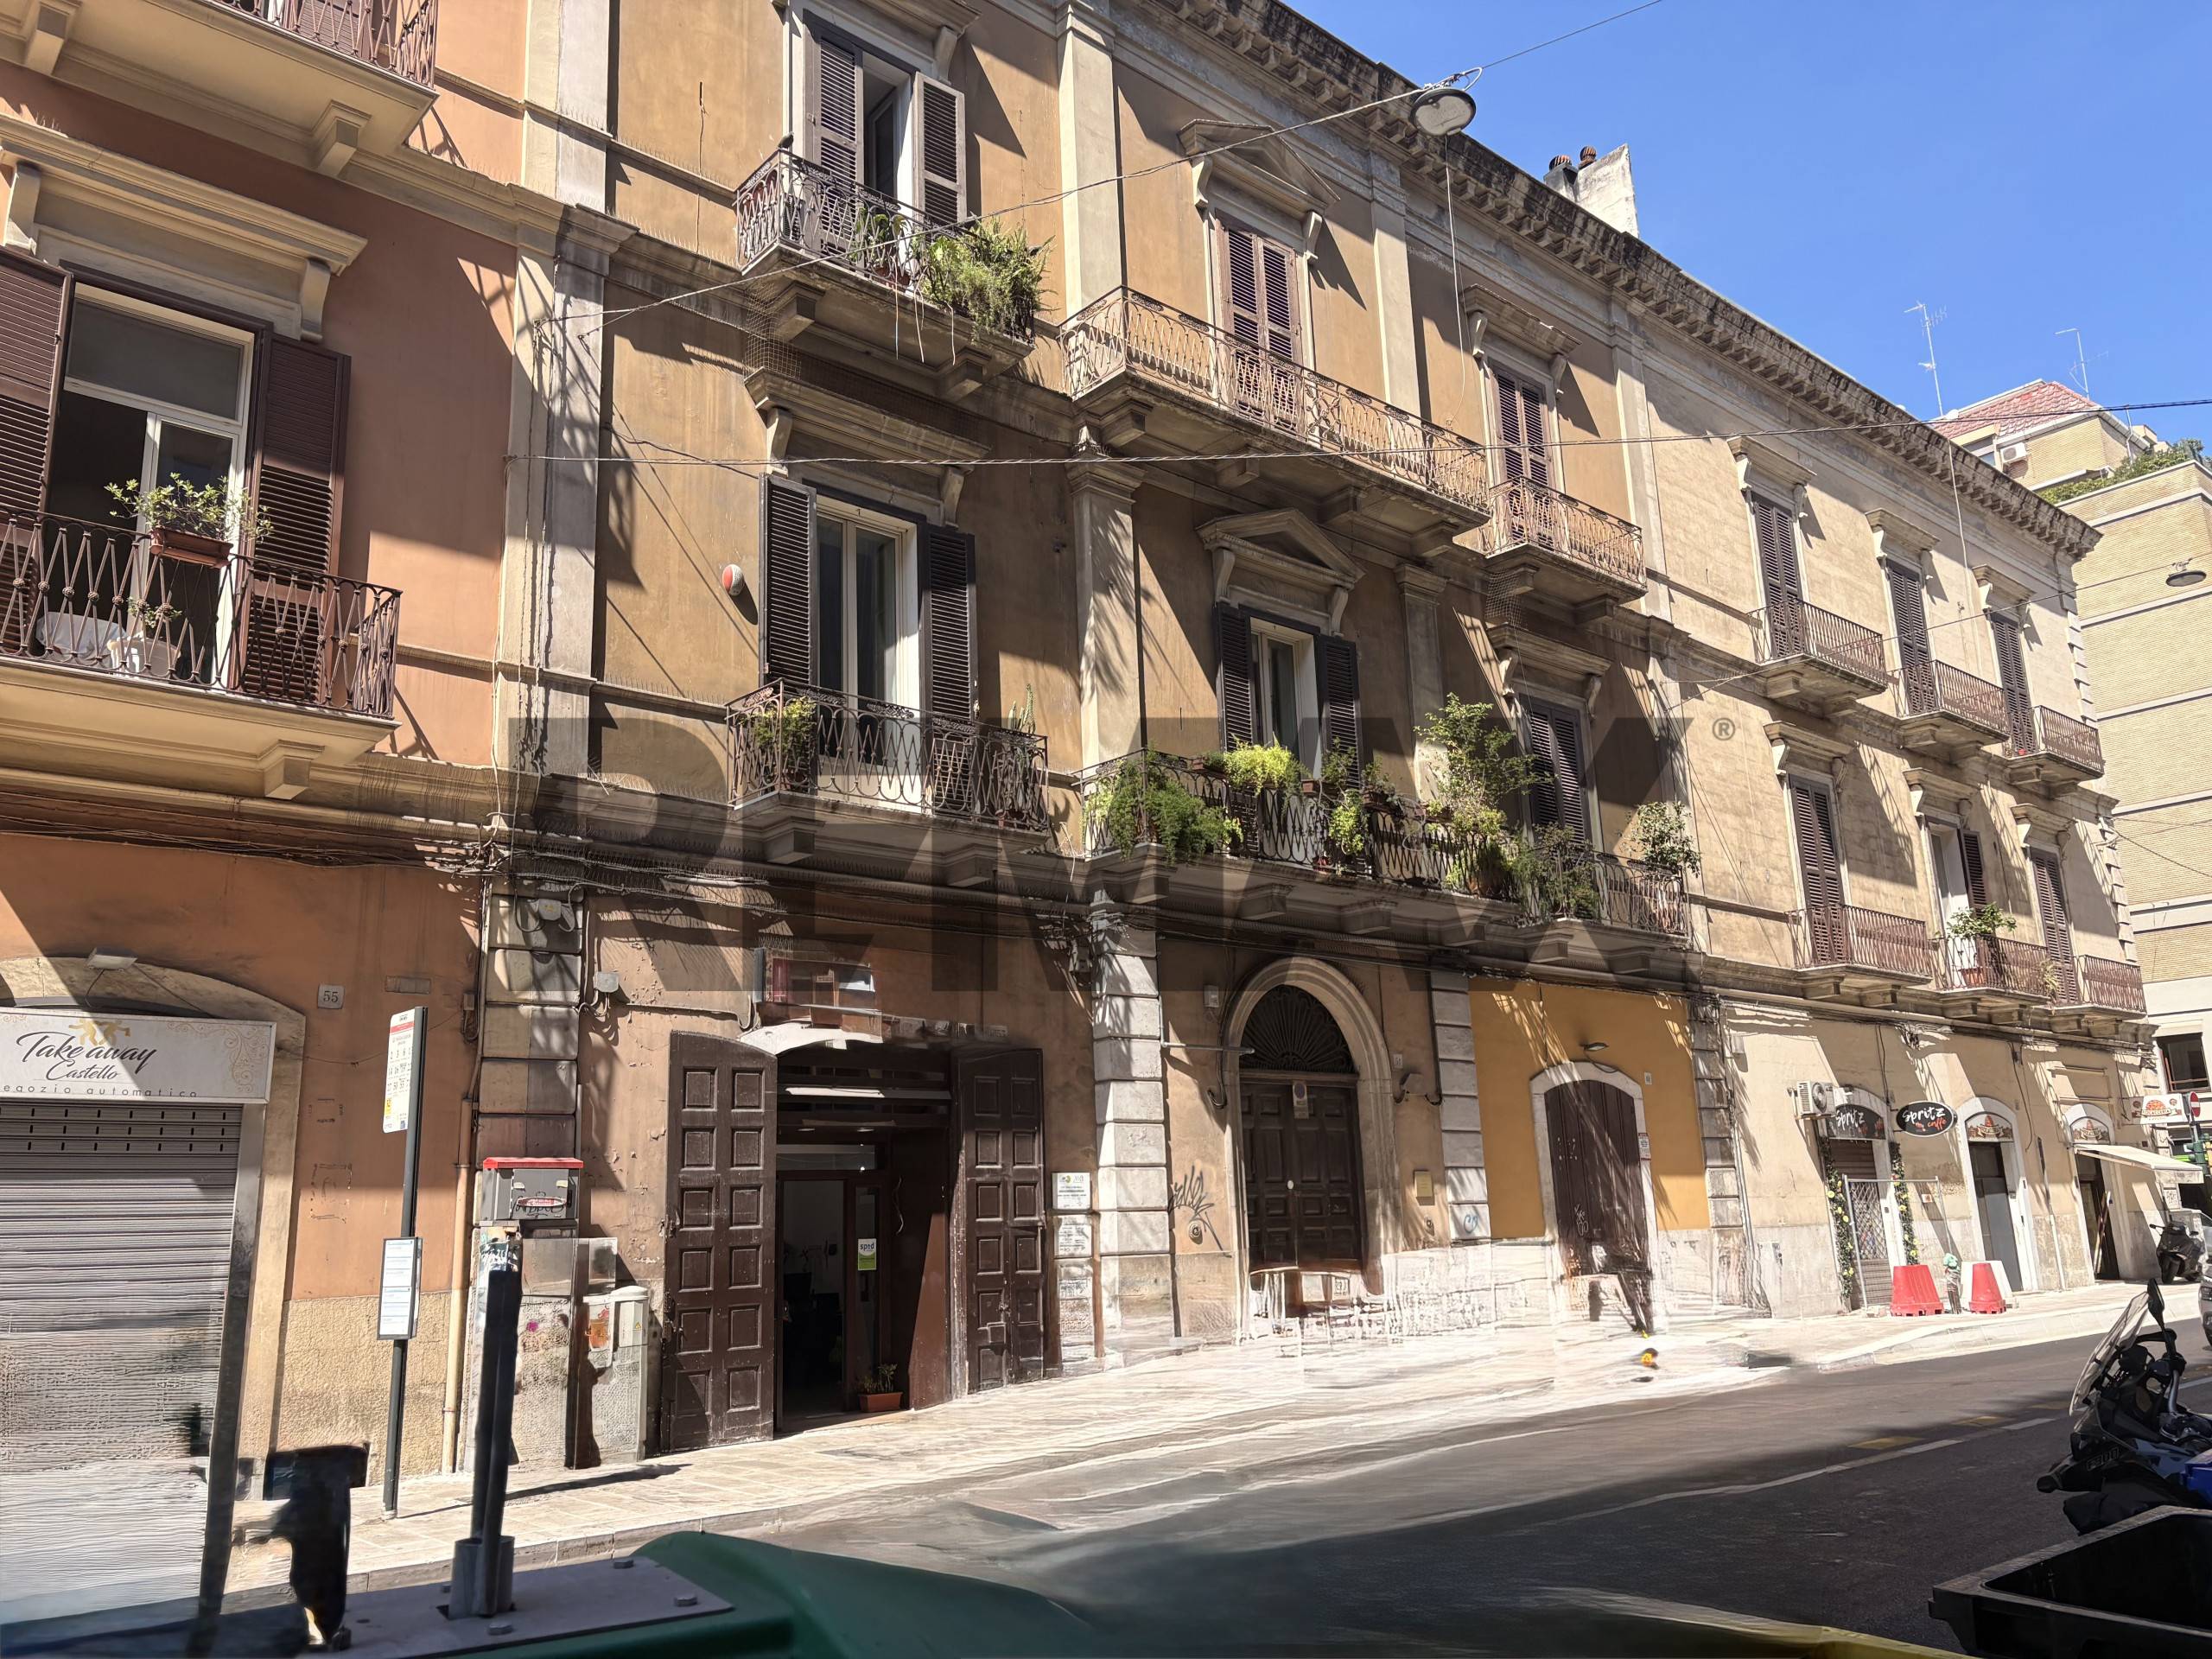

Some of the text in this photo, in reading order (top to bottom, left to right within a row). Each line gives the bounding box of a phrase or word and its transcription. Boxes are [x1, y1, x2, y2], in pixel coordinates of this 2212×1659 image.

[323, 990, 339, 1003] 55
[16, 1031, 157, 1075] Take away
[46, 1059, 120, 1081] Castello
[1902, 1107, 1946, 1124] Spritz
